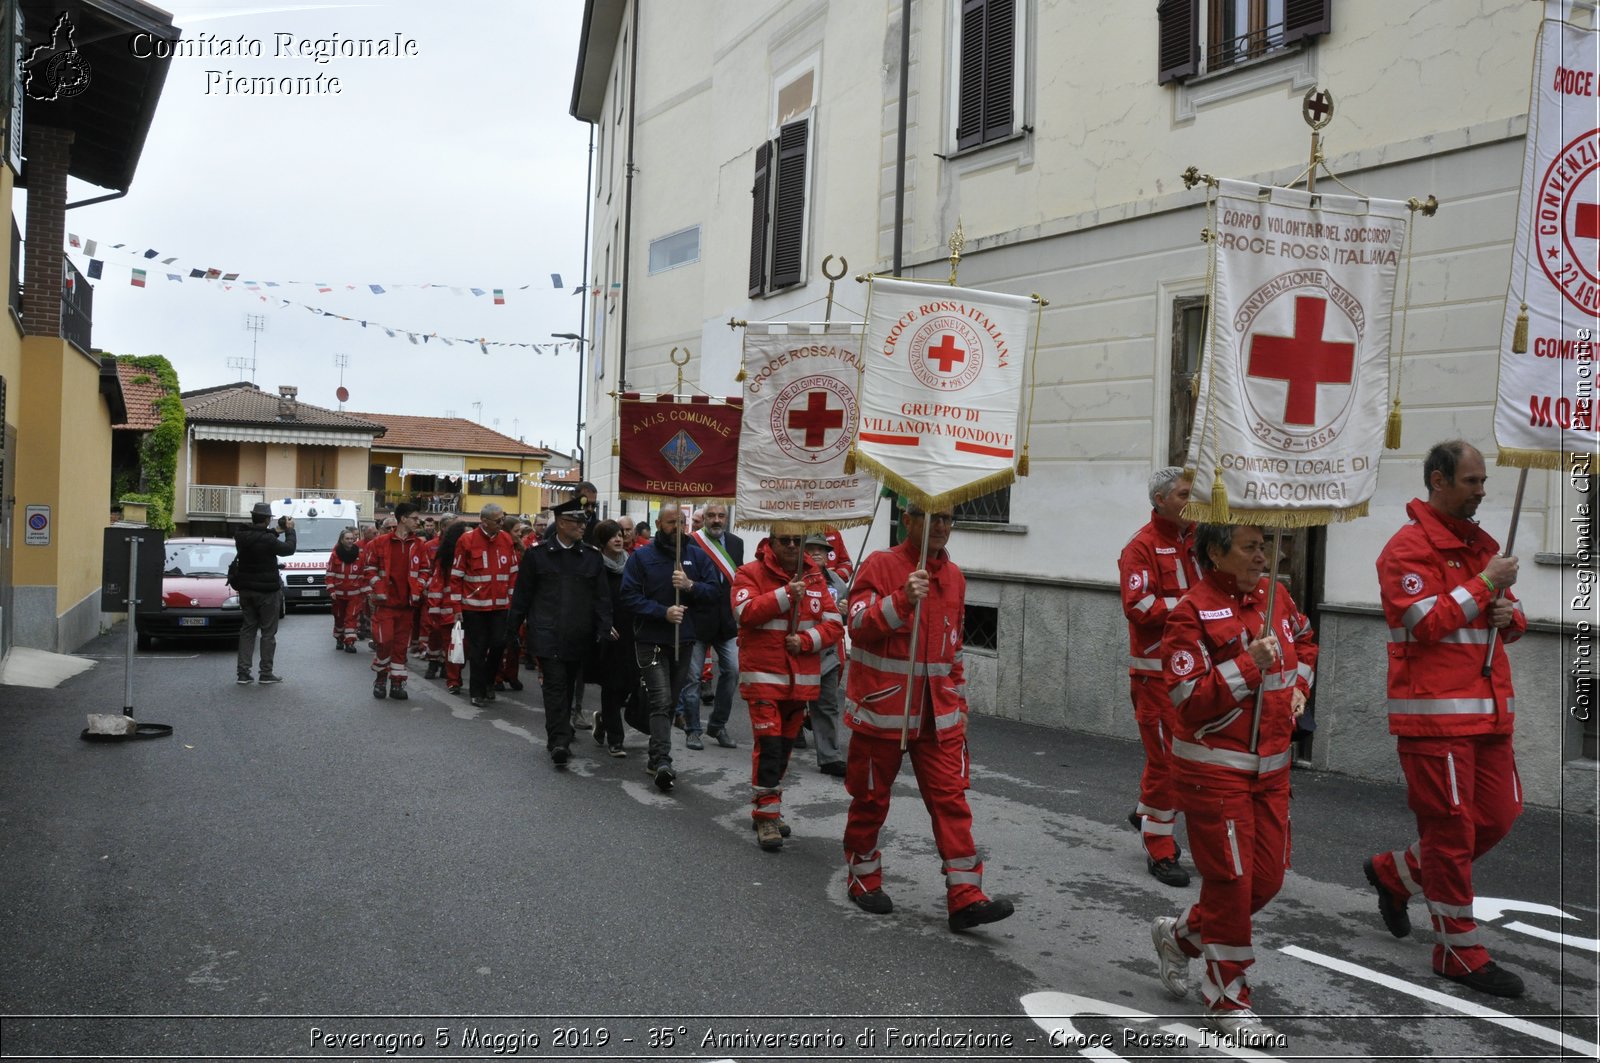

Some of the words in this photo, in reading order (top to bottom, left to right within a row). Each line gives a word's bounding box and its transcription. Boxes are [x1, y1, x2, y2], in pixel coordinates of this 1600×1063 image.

[1554, 66, 1593, 96] CROCE
[1540, 141, 1600, 235] CONVENZI
[1223, 210, 1261, 230] CORPO
[1326, 225, 1340, 242] DEL
[1345, 228, 1391, 244] SOCCORSO
[1217, 232, 1276, 256] CROCE
[1554, 263, 1579, 288] 22
[1574, 281, 1600, 310] AGO
[1234, 272, 1323, 333] CONVENZIONE
[882, 310, 918, 357] CROCE
[919, 300, 967, 316] ROSSA
[968, 307, 1010, 369] ITALIANA
[924, 326, 935, 336] DI
[934, 318, 970, 338] GINEVRA
[967, 335, 978, 347] 22
[749, 354, 788, 394] CROCE
[788, 345, 837, 361] ROSSA
[839, 349, 866, 374] ITALI
[911, 333, 939, 387] CONVENZIONE
[965, 346, 980, 380] AGOSTO
[633, 412, 668, 435] A.V.I.S.
[670, 410, 731, 437] COMUNALE
[773, 390, 793, 451] CONVENZIONE
[791, 383, 801, 393] DI
[800, 378, 838, 391] GINEVRA
[838, 387, 850, 398] 22
[901, 402, 962, 419] GRUPPO
[966, 409, 980, 422] DI
[863, 417, 943, 435] VILLANOVA
[944, 424, 1013, 446] MONDOVI'
[1220, 453, 1289, 474] COMITATO
[1294, 458, 1346, 475] LOCALE
[1352, 455, 1369, 472] DI
[646, 480, 713, 492] PEVERAGNO
[760, 480, 817, 490] COMITATO
[819, 479, 859, 489] LOCALE
[1243, 480, 1347, 501] RACCONIGI
[760, 501, 800, 510] LIMONE
[803, 499, 856, 510] PIEMONTE
